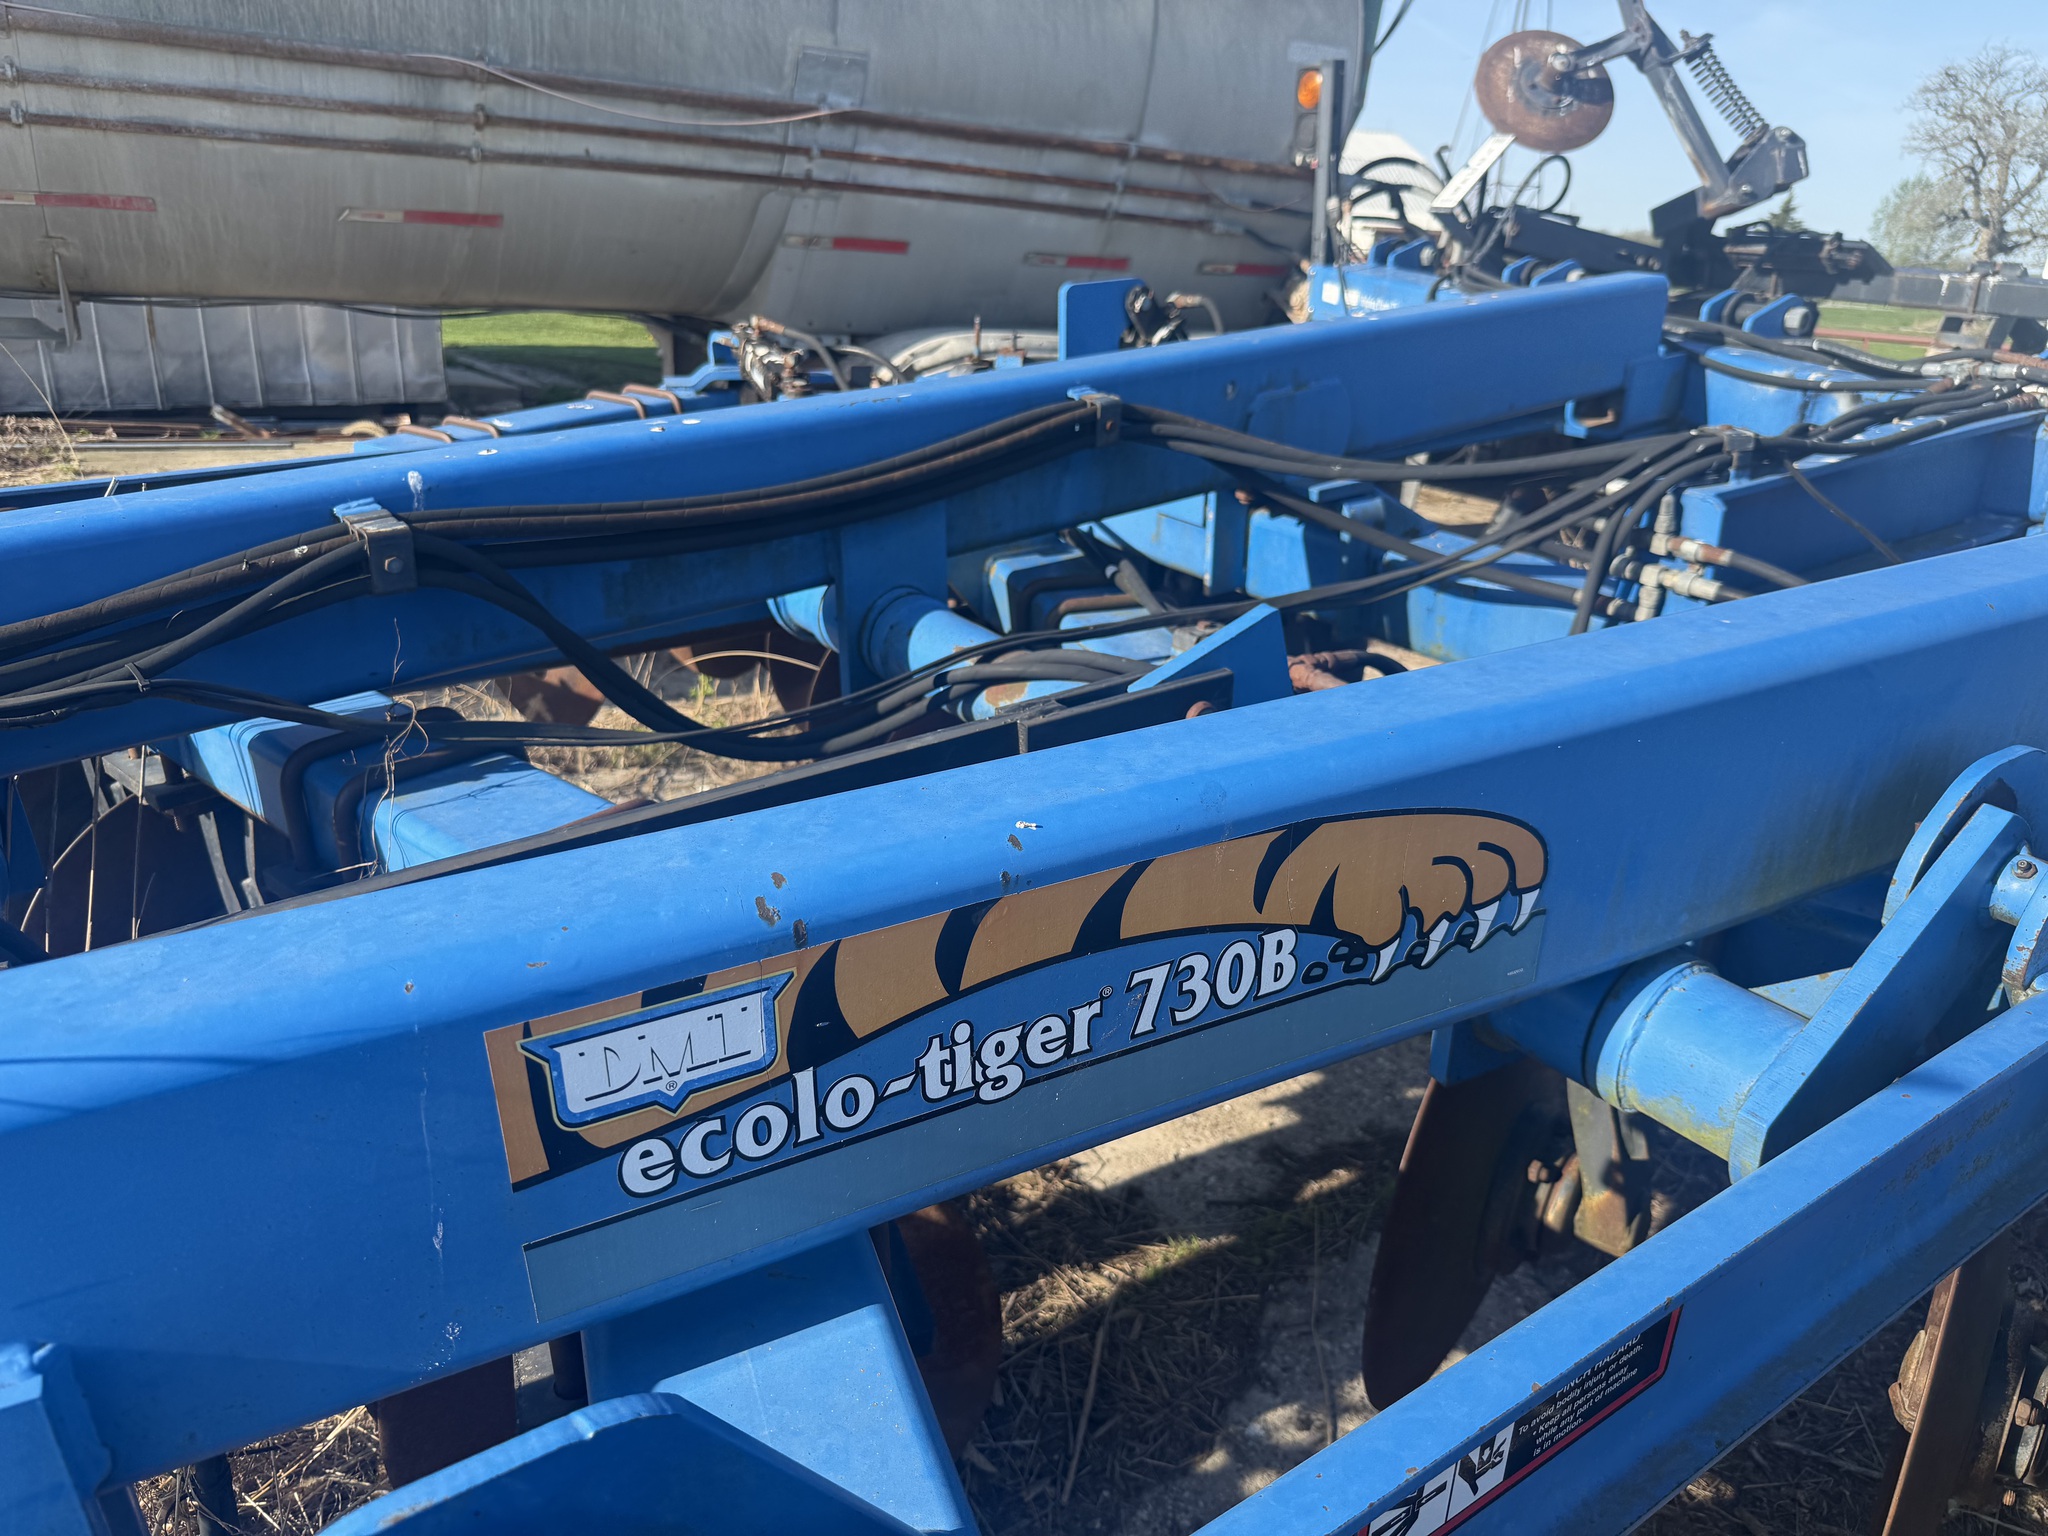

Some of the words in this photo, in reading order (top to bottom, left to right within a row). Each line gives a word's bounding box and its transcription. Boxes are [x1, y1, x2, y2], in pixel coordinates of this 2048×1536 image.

[1126, 926, 1299, 1040] 730B
[579, 1005, 752, 1102] DMI
[1519, 1424, 1528, 1435] To
[1531, 1404, 1554, 1427] avoid
[1556, 1387, 1582, 1409] bodily
[1584, 1369, 1606, 1390] injury
[1609, 1363, 1616, 1372] or
[1619, 1344, 1643, 1363] death:
[1536, 1426, 1558, 1444] while
[1560, 1413, 1575, 1428] any
[1577, 1398, 1592, 1418] part
[1595, 1392, 1603, 1403] of
[1605, 1368, 1638, 1395] machine
[1539, 1414, 1560, 1433] Keep
[1562, 1405, 1571, 1416] all
[1574, 1381, 1606, 1410] persons
[1608, 1365, 1629, 1384] away
[1533, 1447, 1540, 1456] is
[1543, 1439, 1551, 1450] in
[1553, 1418, 1583, 1441] motion.
